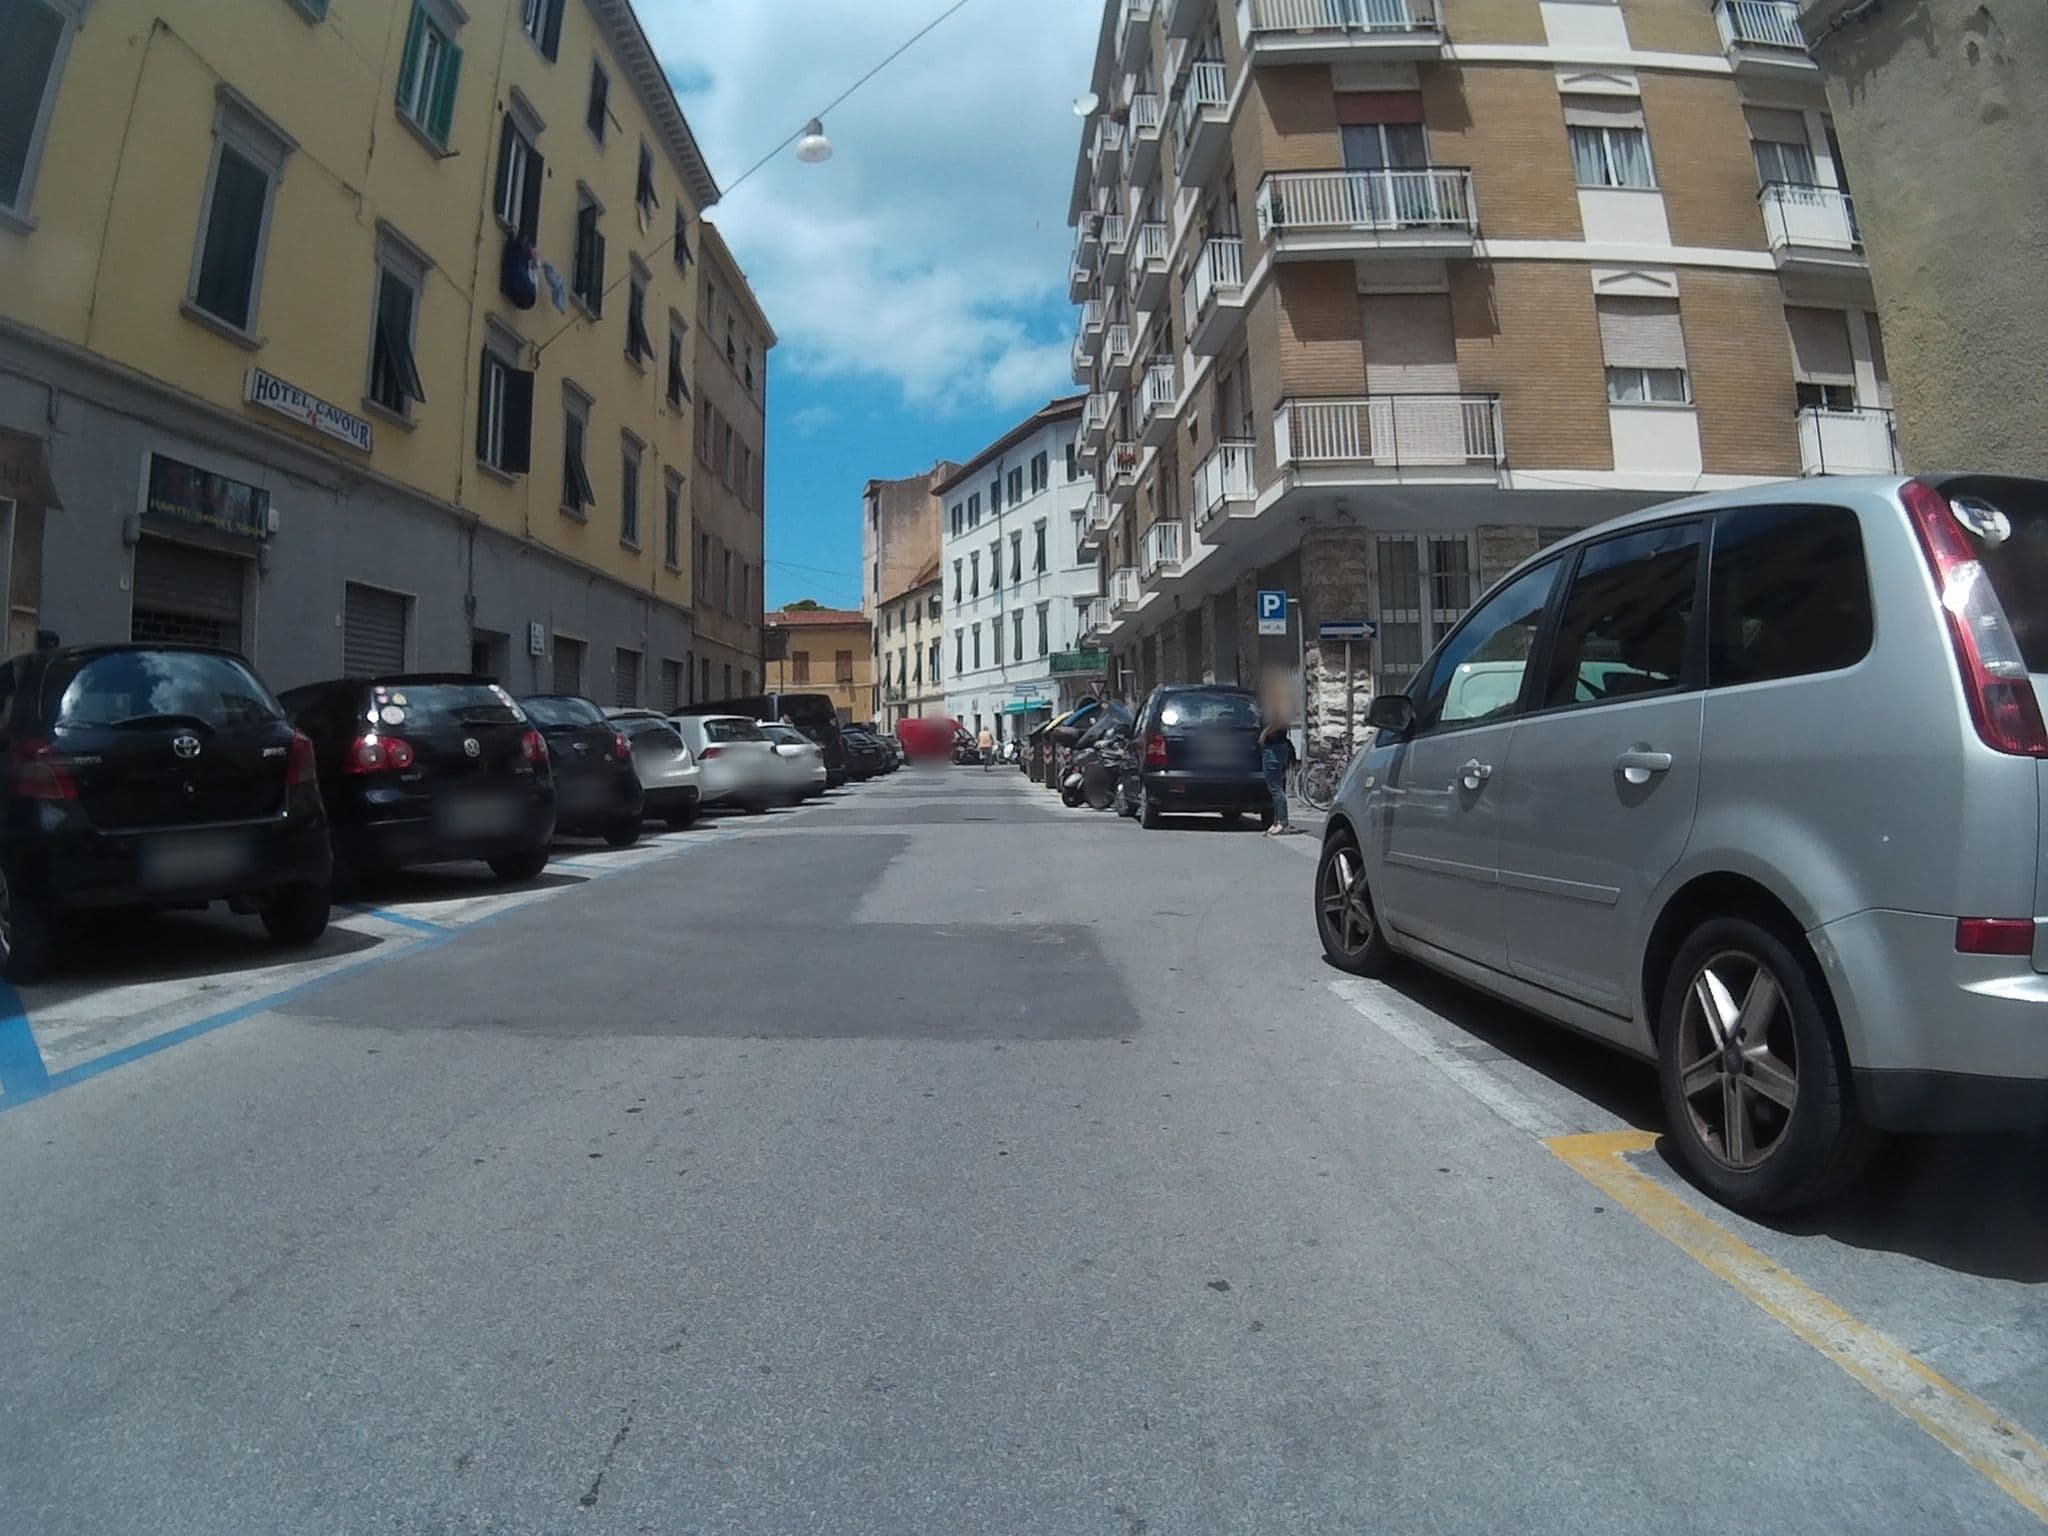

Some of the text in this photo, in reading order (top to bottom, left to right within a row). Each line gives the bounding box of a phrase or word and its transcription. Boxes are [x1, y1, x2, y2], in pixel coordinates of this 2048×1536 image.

[256, 373, 370, 449] HOTEL CAVOUR
[1263, 594, 1281, 617] P
